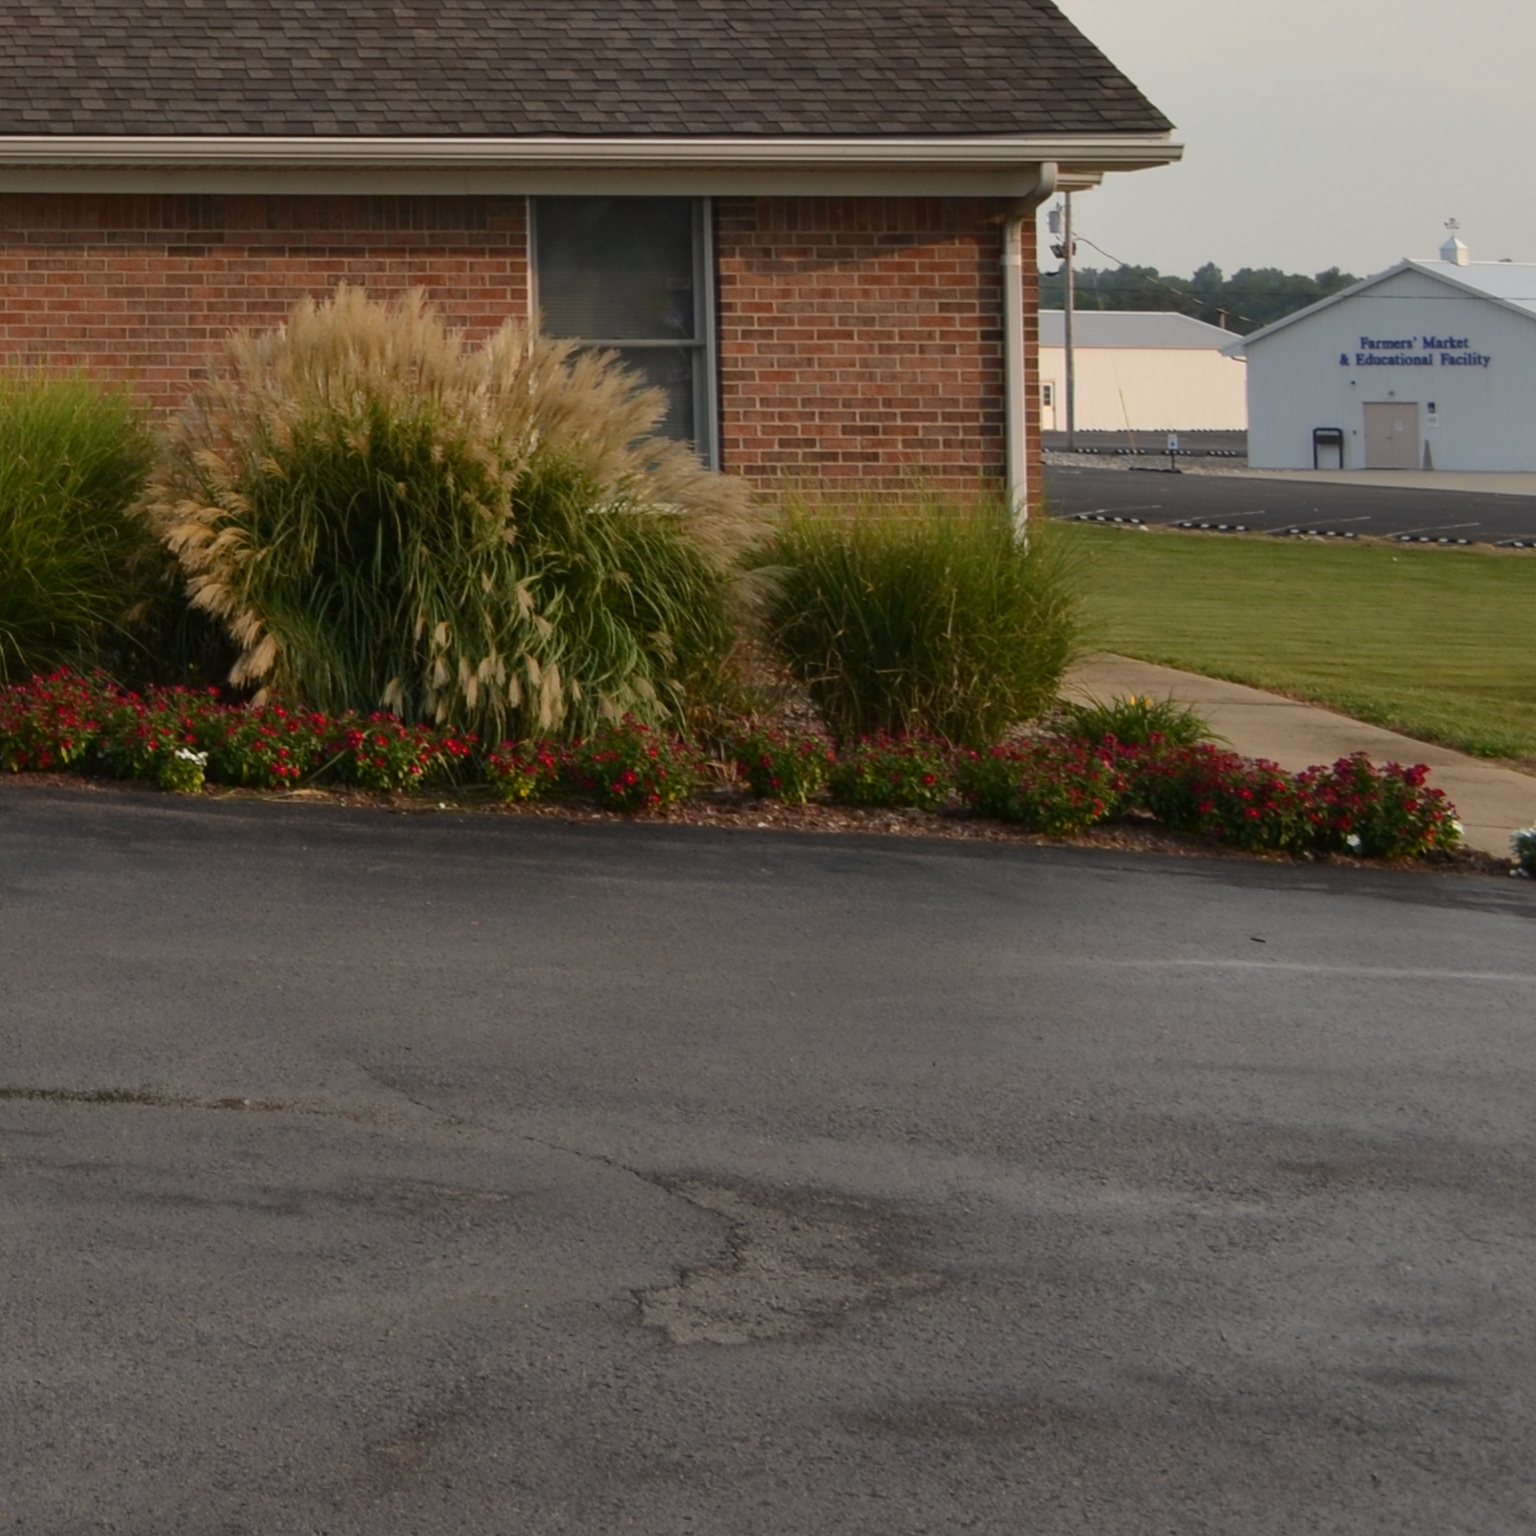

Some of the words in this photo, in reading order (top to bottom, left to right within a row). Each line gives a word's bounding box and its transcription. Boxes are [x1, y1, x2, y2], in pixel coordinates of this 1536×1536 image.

[1422, 336, 1469, 349] Market
[1339, 353, 1349, 366] &
[1355, 352, 1433, 366] Educational
[1440, 352, 1491, 368] Facility
